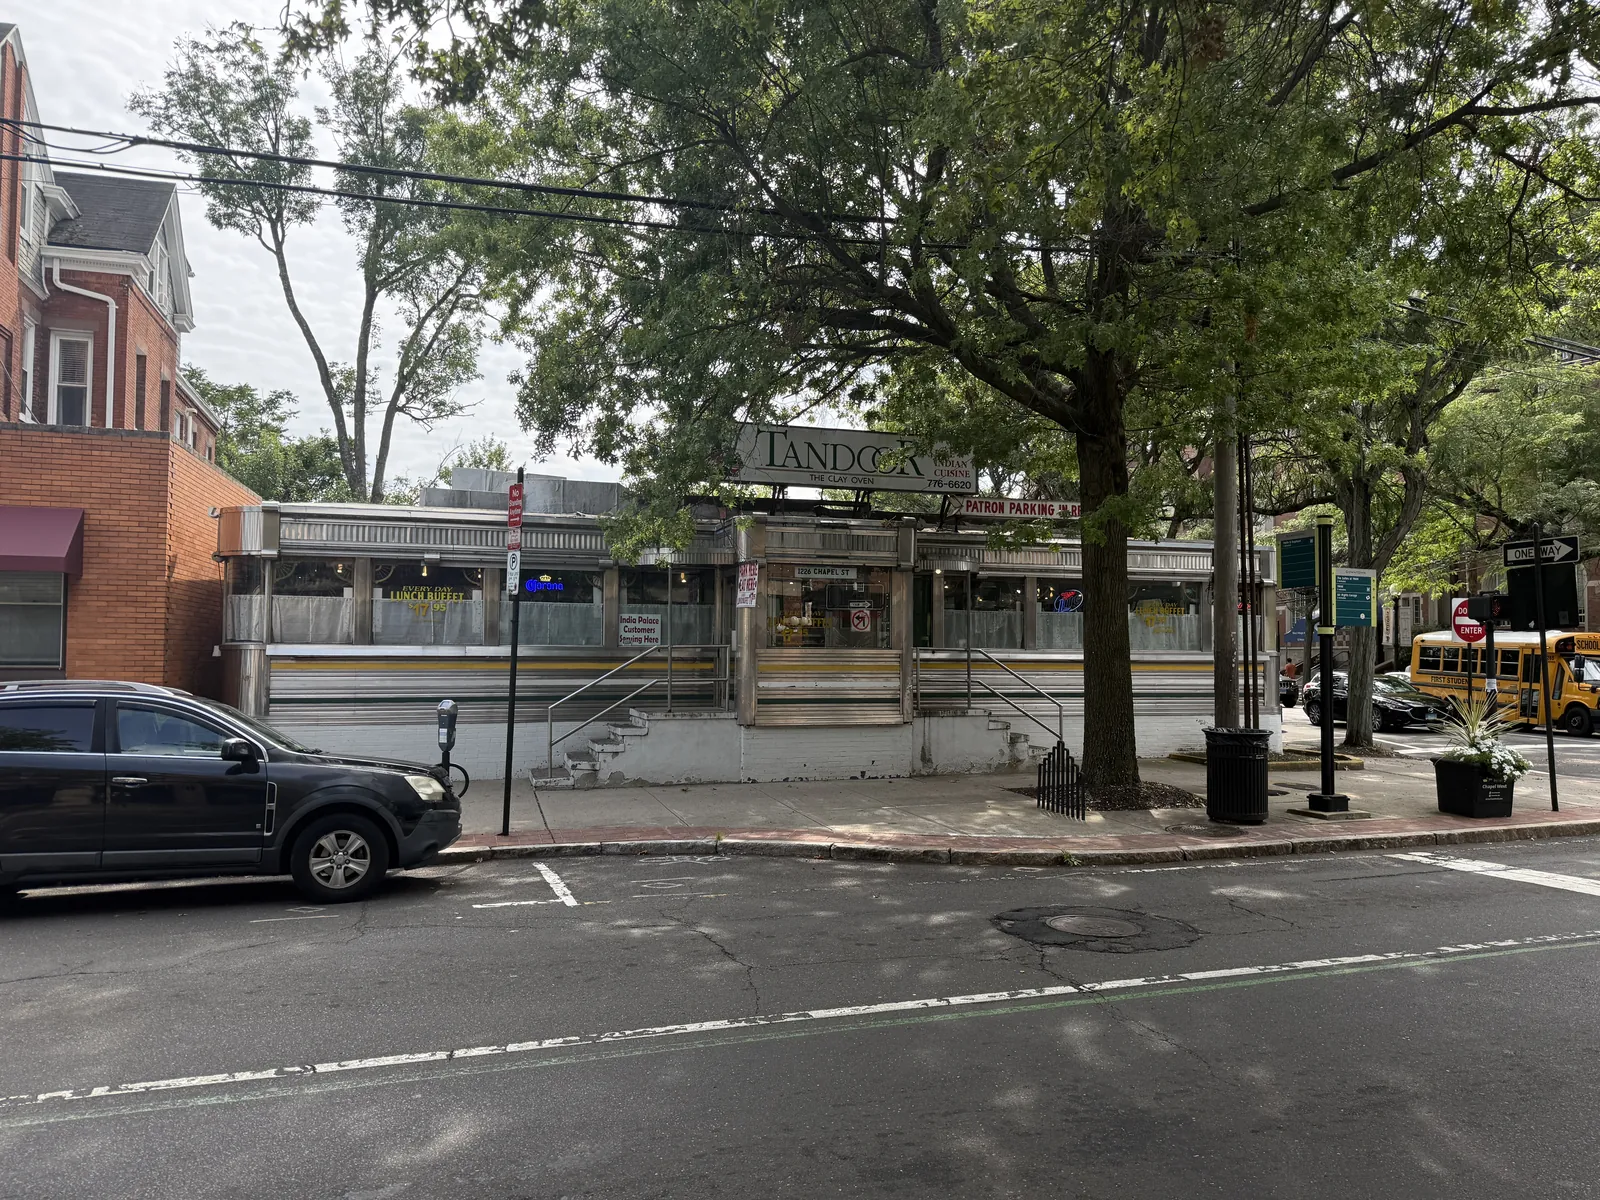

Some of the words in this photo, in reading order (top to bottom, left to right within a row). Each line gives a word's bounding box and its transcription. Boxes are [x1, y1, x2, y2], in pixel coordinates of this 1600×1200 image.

[934, 469, 970, 478] CUISINE
[809, 474, 825, 482] THE
[827, 475, 848, 483] CLAY
[851, 476, 874, 485] OVEN
[927, 479, 972, 490] 776-6620
[511, 489, 520, 498] No
[965, 500, 1005, 515] PATRON
[1009, 502, 1055, 516] PARKING
[1514, 548, 1534, 559] ONE
[1540, 545, 1562, 557] WAY
[813, 568, 839, 576] CHAPEL
[525, 579, 564, 592] Corona
[390, 591, 424, 602] LUNCH
[427, 591, 464, 603] BUFFET
[1458, 607, 1468, 615] DO
[620, 616, 637, 624] India
[638, 616, 659, 625] Palace
[623, 625, 655, 634] Customers
[1460, 627, 1482, 635] ENTER
[619, 634, 642, 645] Serving
[643, 635, 659, 643] Here
[1576, 639, 1600, 650] SCHOOL
[1430, 675, 1445, 683] FIRST
[1447, 677, 1473, 685] STUDEN
